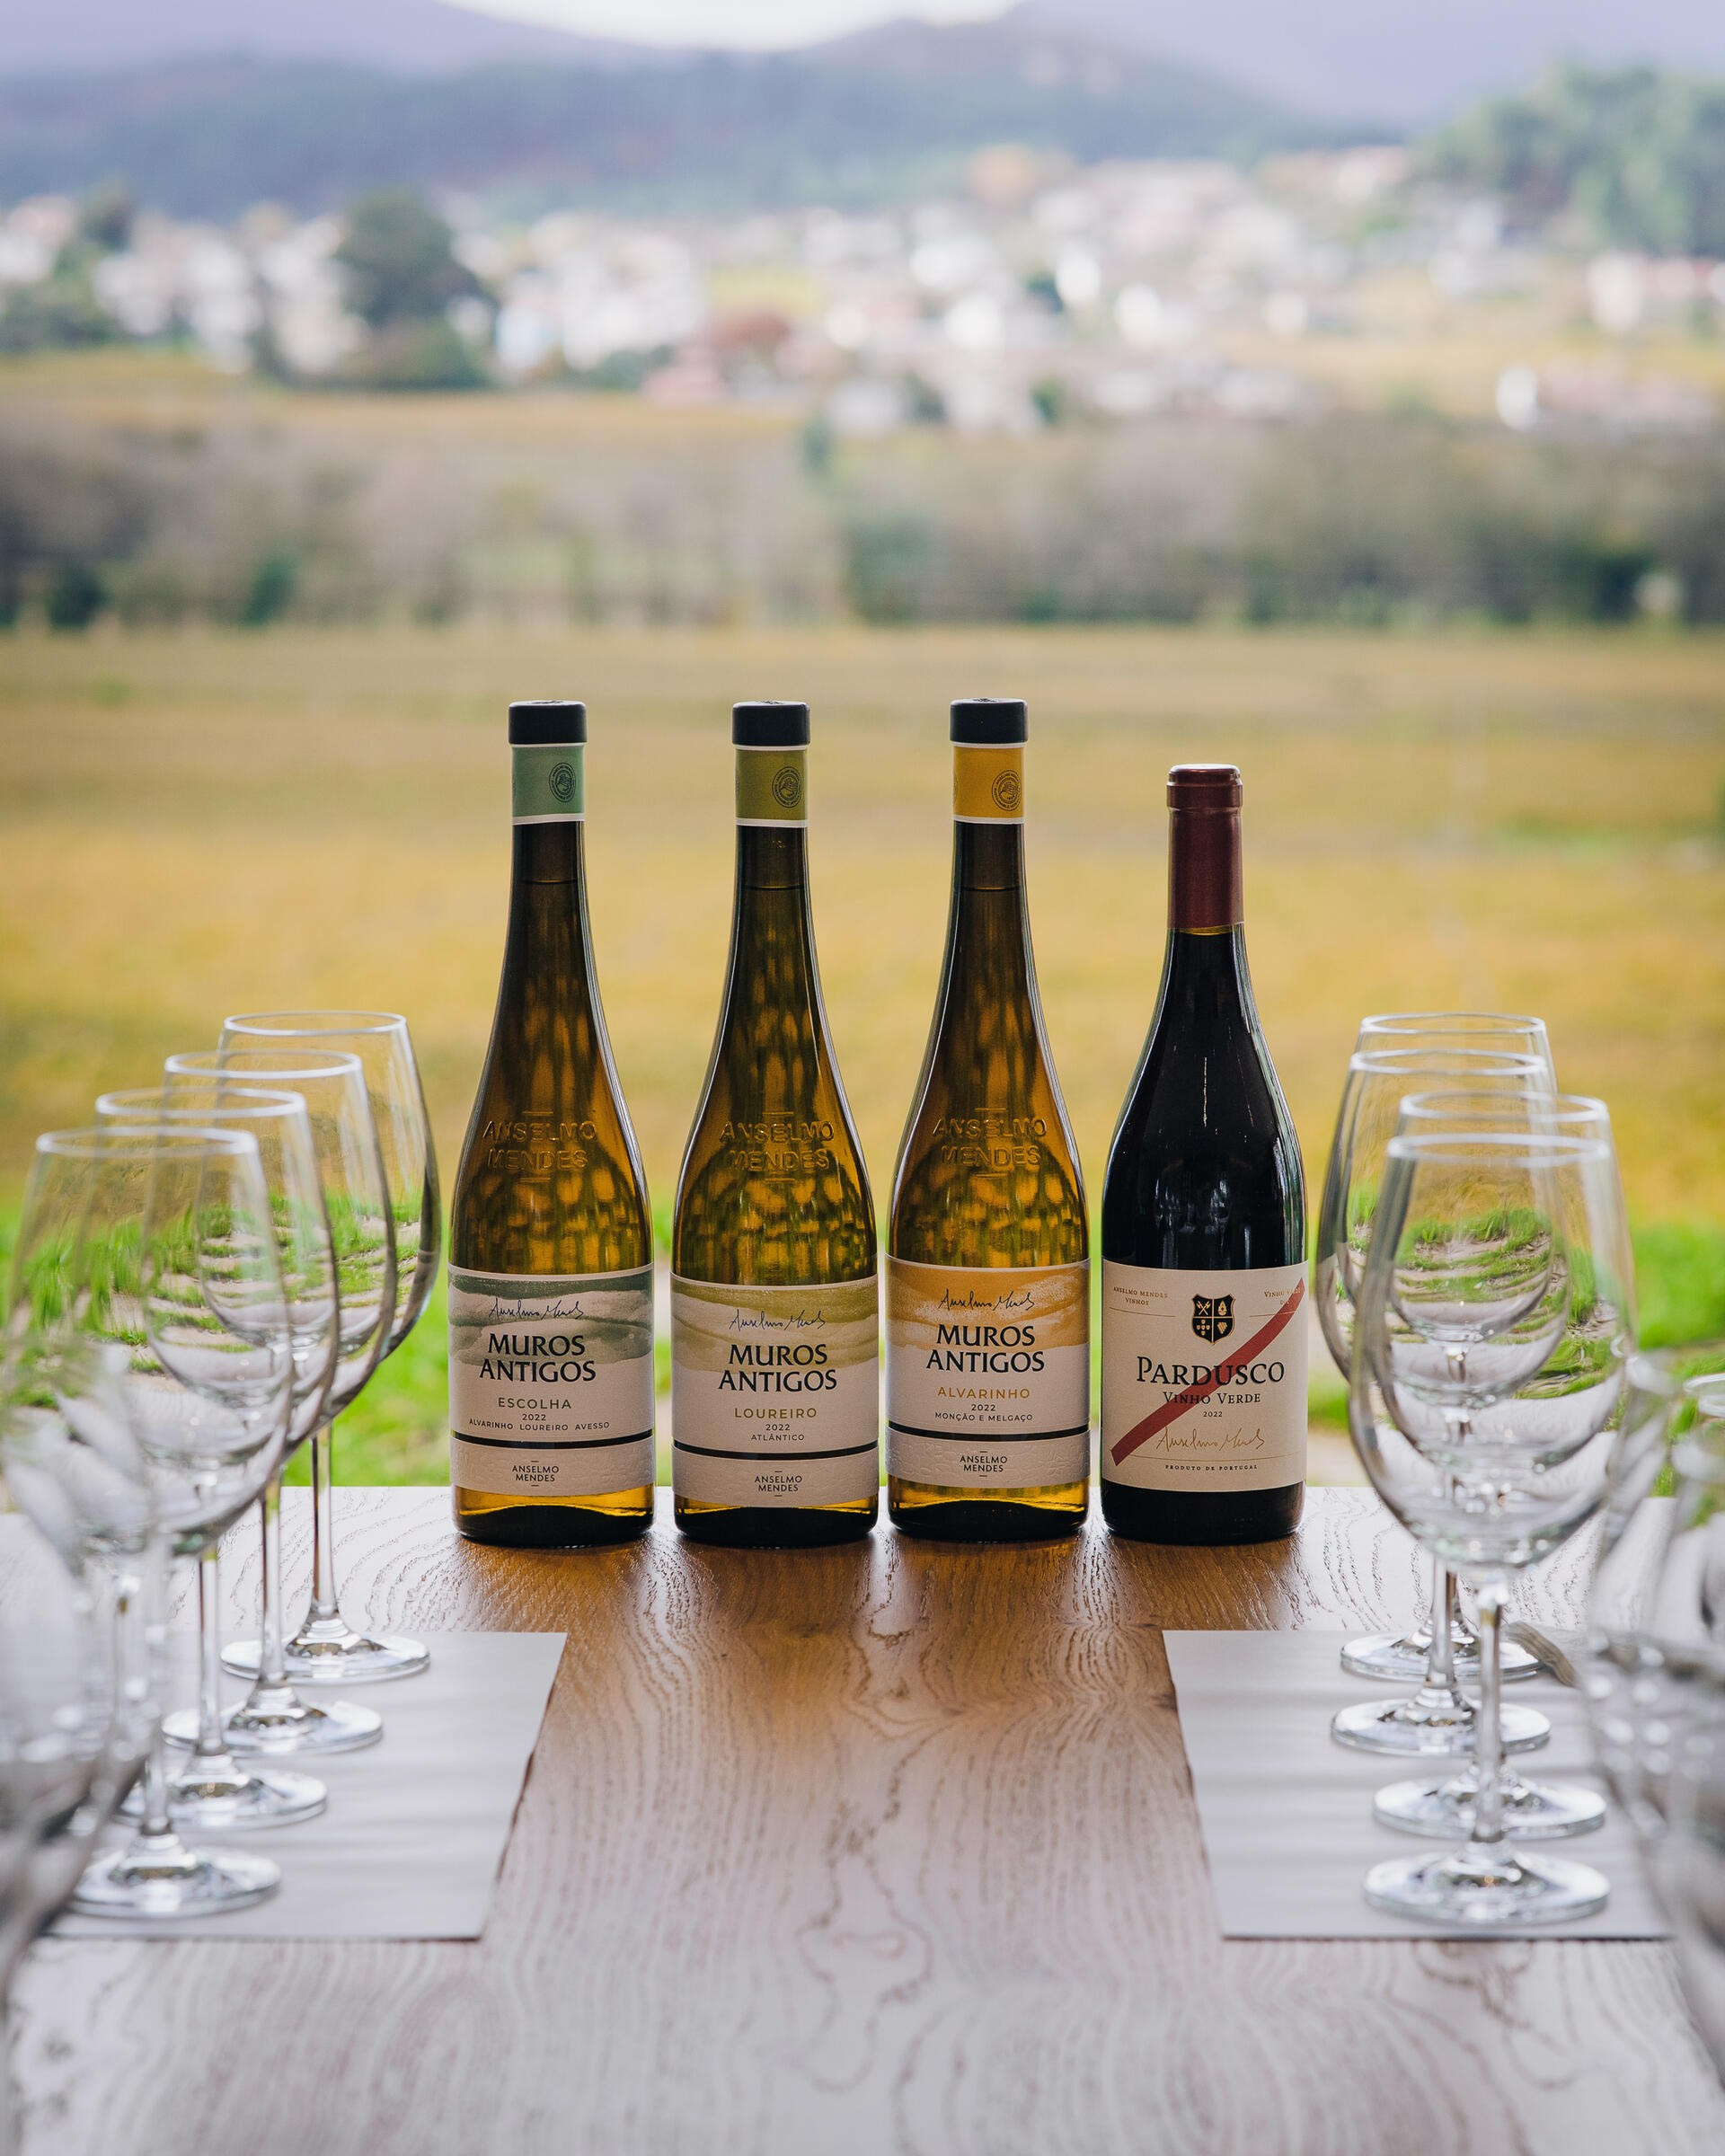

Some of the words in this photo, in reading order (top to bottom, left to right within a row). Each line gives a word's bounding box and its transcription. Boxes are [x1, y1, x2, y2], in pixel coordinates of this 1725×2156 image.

[482, 1120, 597, 1143] ANSELMO
[720, 1120, 834, 1143] ANSELMO
[933, 1118, 1047, 1139] ANSELMO
[488, 1149, 588, 1171] MENDES
[729, 1148, 829, 1171] MENDES
[941, 1144, 1041, 1166] MENDES
[936, 1324, 1036, 1347] MUROS
[487, 1333, 586, 1356] MUROS
[729, 1343, 827, 1366] MUROS
[925, 1349, 1045, 1373] ANTIGOS
[479, 1358, 597, 1383] ANTIGOS
[1137, 1356, 1285, 1386] PARDUSCO
[718, 1369, 837, 1392] ANTIGOS
[937, 1386, 1030, 1399] ALVARINHO
[1163, 1391, 1211, 1404] VINHO
[1216, 1392, 1261, 1404] VERDE
[498, 1397, 571, 1409] ESCOLHA
[522, 1413, 546, 1421] 2022
[734, 1408, 817, 1418] LOUREIRO
[934, 1411, 976, 1421] MONÇÃO
[988, 1414, 1033, 1422] MELGAÇO
[469, 1418, 513, 1430] ALVARINHO
[519, 1423, 569, 1431] LOUREIRO
[575, 1421, 610, 1430] AVESSO
[751, 1433, 805, 1441] ATLÂNTICO
[960, 1455, 1007, 1463] ANSELMO
[511, 1465, 559, 1473] ANSELMO
[963, 1464, 1004, 1472] MENDES
[515, 1473, 555, 1482] MENDES
[754, 1475, 802, 1483] ANSELMO
[758, 1484, 799, 1492] MENDES
